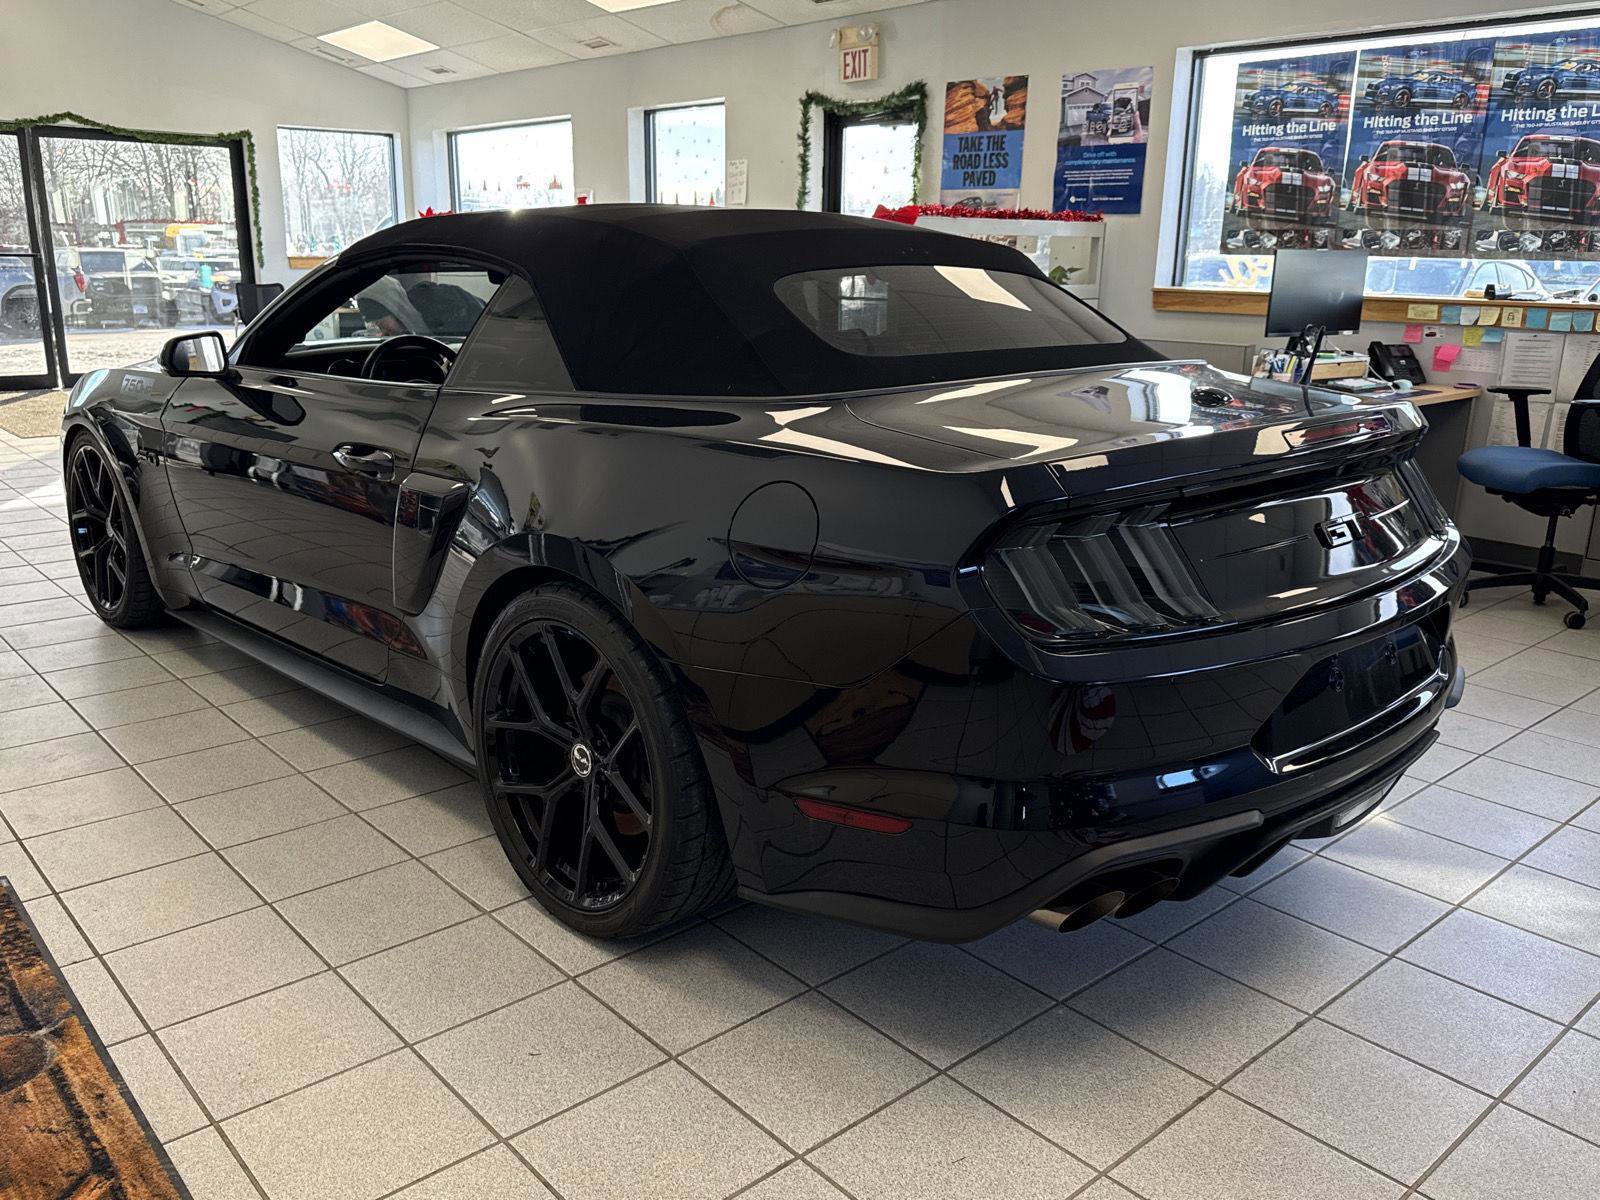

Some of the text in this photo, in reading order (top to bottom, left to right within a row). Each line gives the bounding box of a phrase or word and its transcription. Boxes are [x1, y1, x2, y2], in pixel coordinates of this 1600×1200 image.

[843, 48, 869, 80] EXIT
[1363, 111, 1473, 129] Hitting the Line
[1501, 107, 1557, 122] Hitting
[1560, 104, 1588, 119] the
[1242, 120, 1337, 137] Hitting the Line
[958, 134, 1007, 153] TAKE THE
[952, 152, 1009, 170] ROAD LESS
[962, 170, 996, 187] PAVED
[1314, 511, 1365, 550] GT
